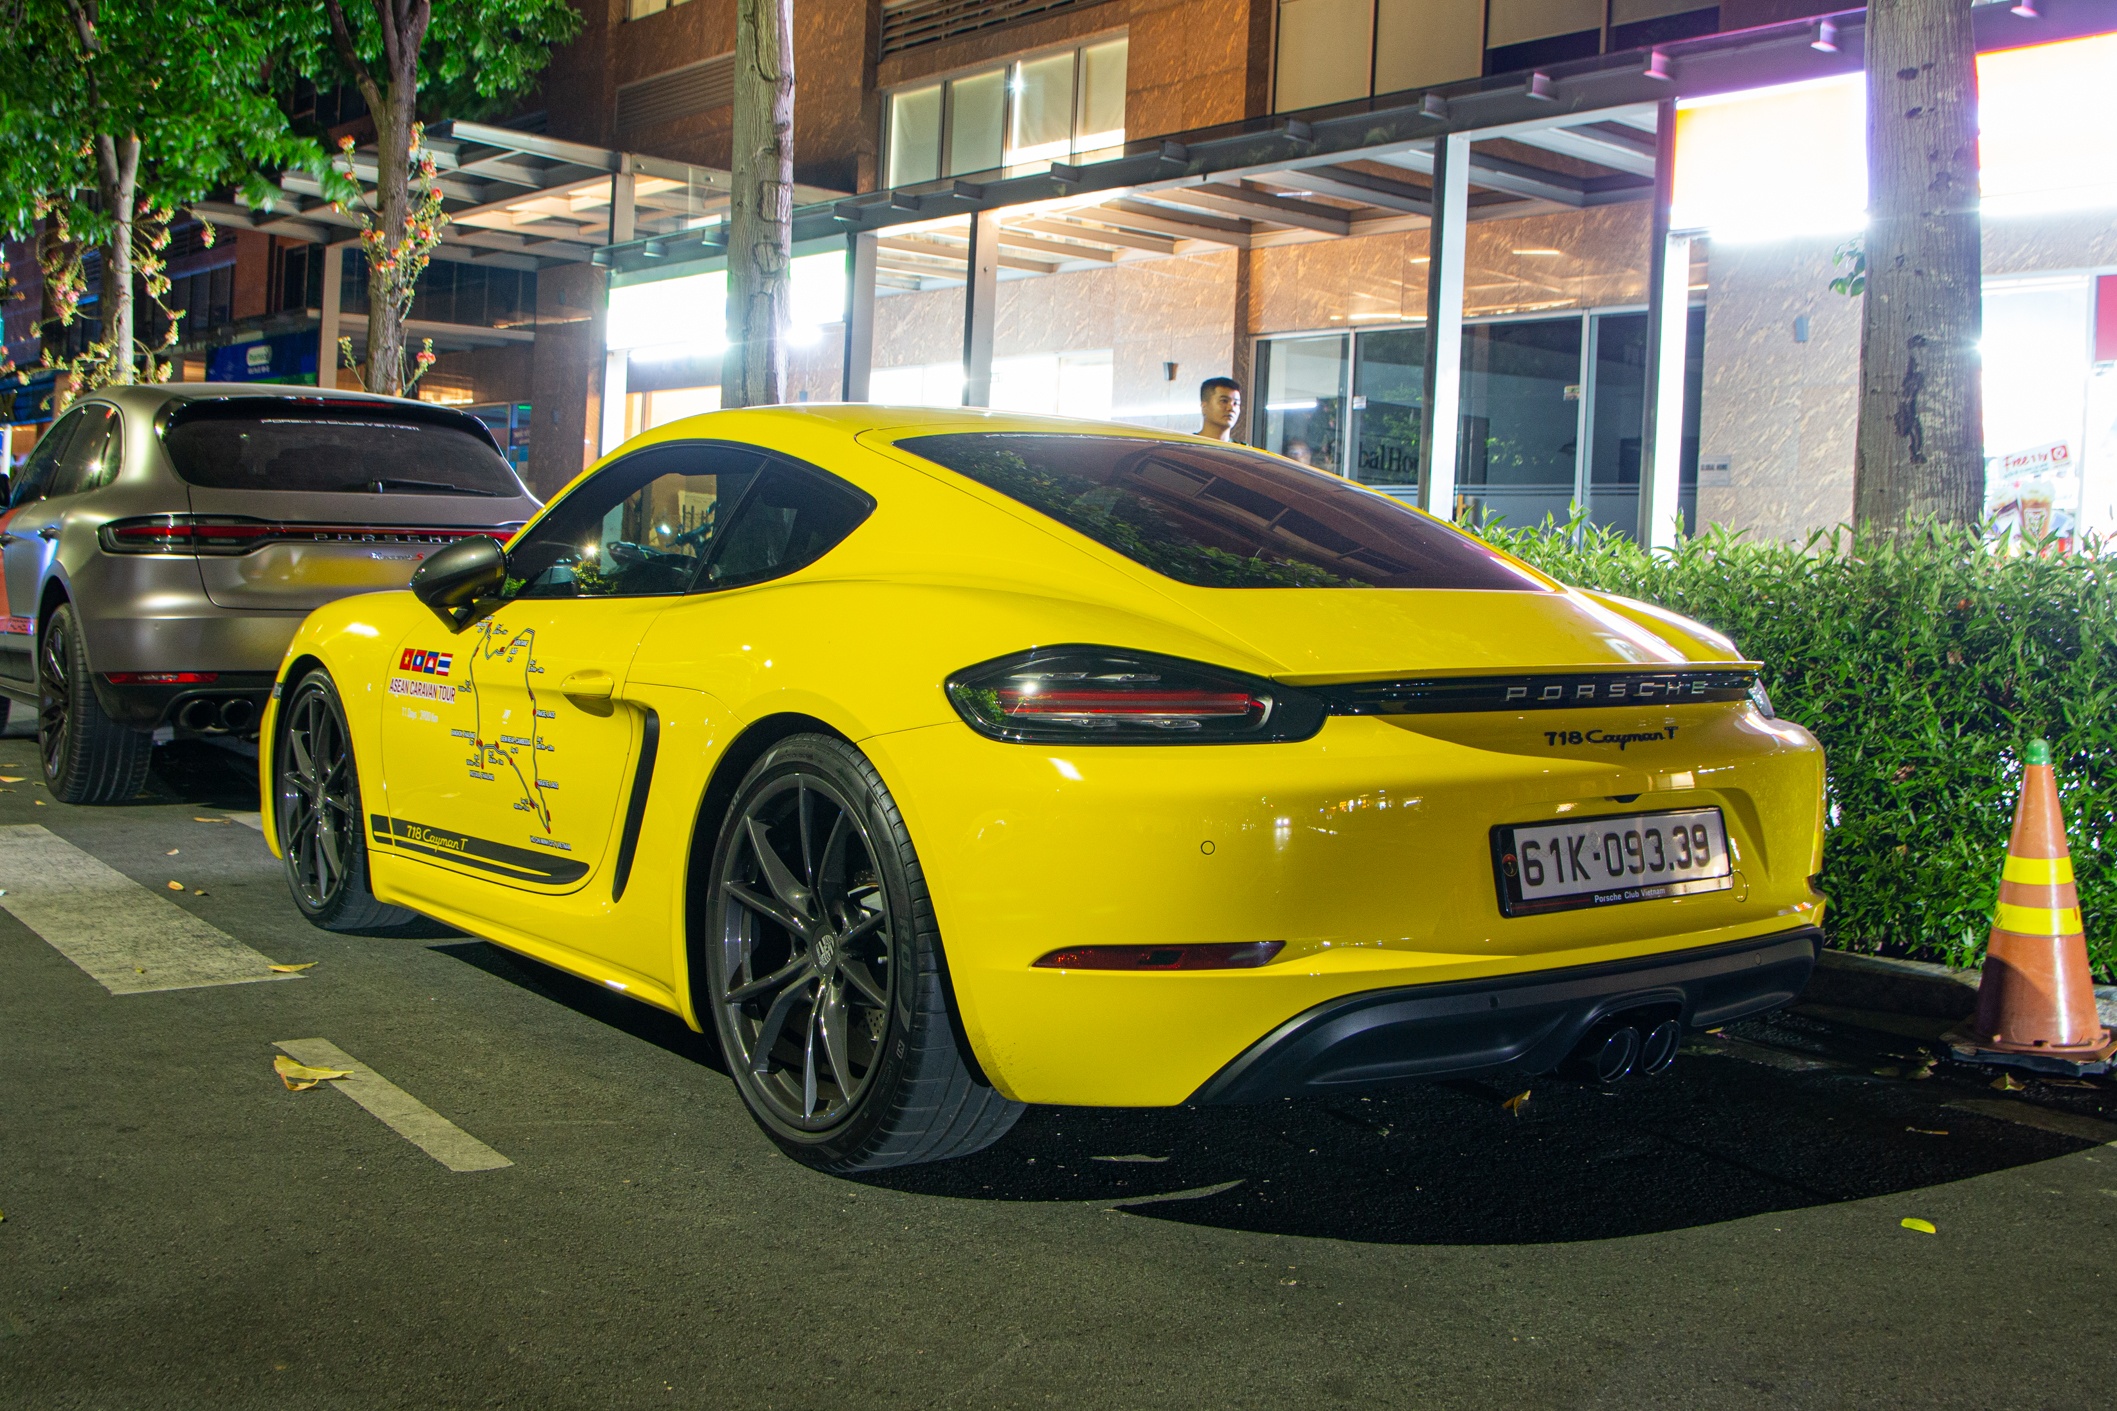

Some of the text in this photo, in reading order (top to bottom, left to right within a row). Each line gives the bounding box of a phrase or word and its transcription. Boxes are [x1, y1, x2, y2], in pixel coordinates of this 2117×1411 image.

[389, 677, 409, 695] ASEAN
[410, 680, 437, 700] CARAVAN
[438, 684, 456, 704] TOUR
[1506, 681, 1706, 701] PORSCHE
[1544, 726, 1679, 751] 718 Cayman T
[407, 825, 469, 853] 718 Cayman T
[1521, 824, 1711, 886] 61K-093.39
[1594, 888, 1666, 903] Porsche Club Vietnam
